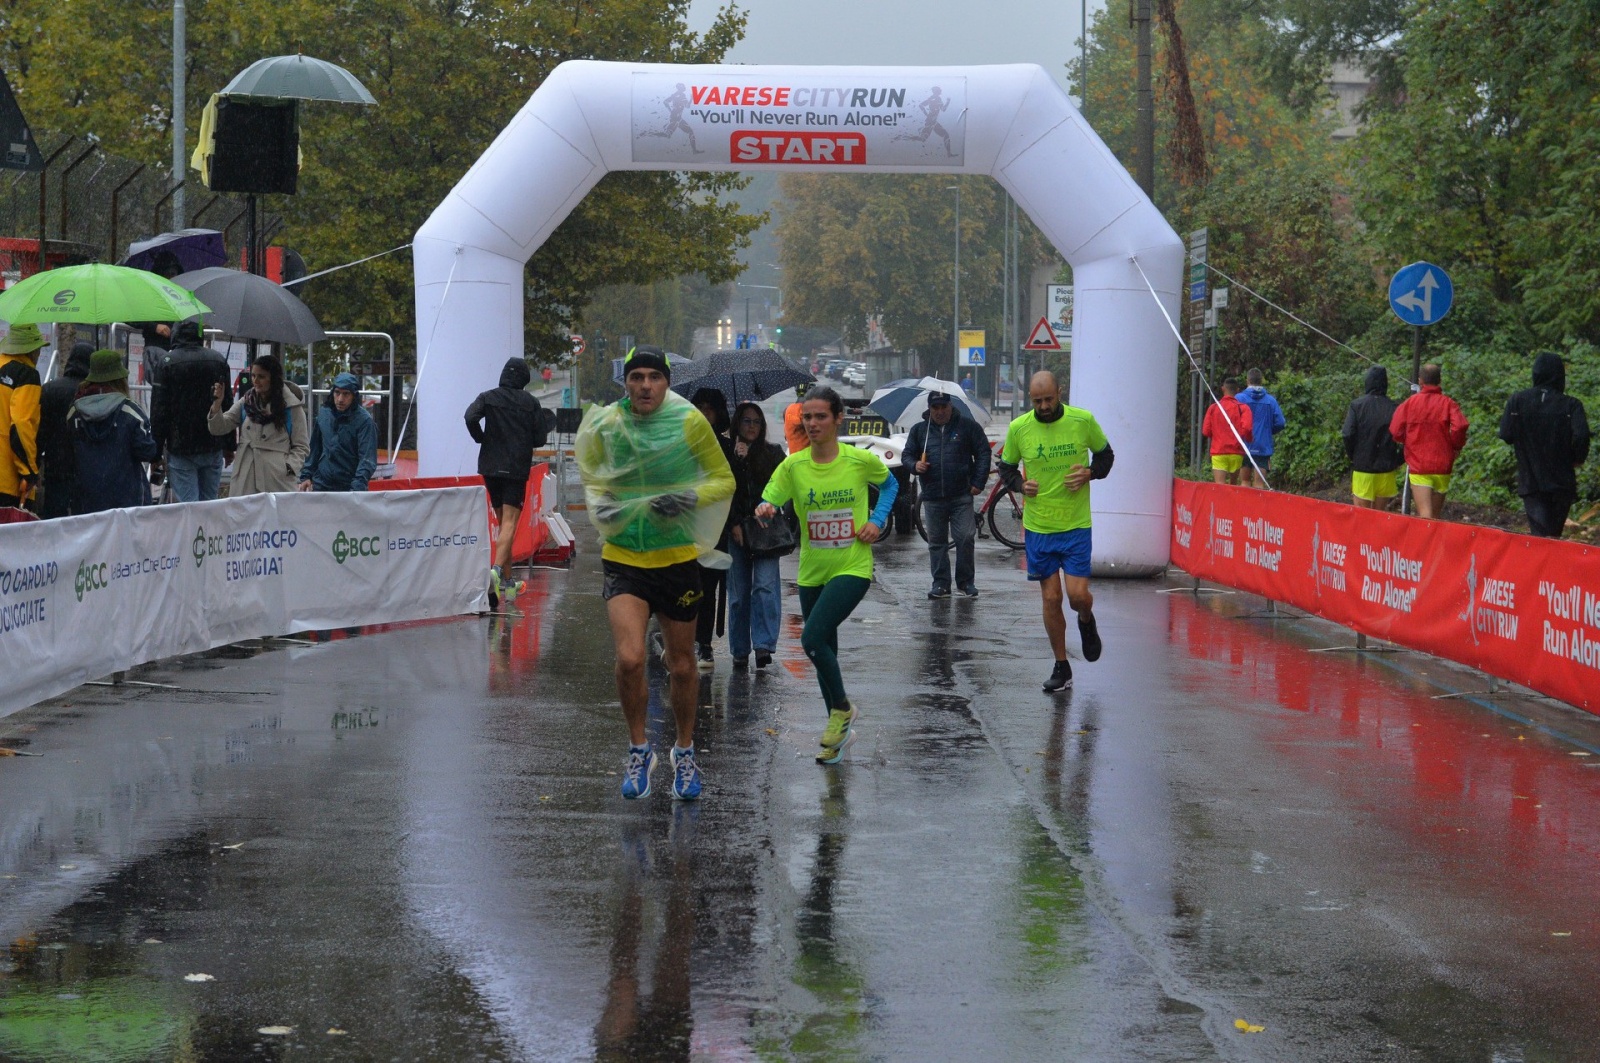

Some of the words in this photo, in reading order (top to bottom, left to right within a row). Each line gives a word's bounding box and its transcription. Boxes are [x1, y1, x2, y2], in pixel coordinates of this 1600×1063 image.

[691, 86, 790, 107] VARESE
[793, 87, 906, 108] CITYRUN
[690, 108, 744, 124] “You’ll
[750, 110, 802, 125] Never
[805, 111, 838, 126] Run
[843, 110, 906, 126] Alone!”
[737, 136, 860, 162] START
[1048, 449, 1077, 459] CITYRUN
[1049, 443, 1075, 452] VARESE
[821, 496, 855, 506] CITYRUN
[822, 488, 853, 498] VARESE
[432, 535, 451, 547] Che
[809, 520, 852, 539] 1088
[208, 535, 223, 557] BCC
[226, 532, 251, 554] BUSTO
[350, 536, 381, 557] BCC
[1322, 540, 1347, 567] VARESE
[85, 562, 108, 592] BCC
[1321, 565, 1346, 592] CITYRUN
[1392, 550, 1423, 583] Never
[1361, 574, 1381, 604] Run
[1481, 577, 1515, 609] VARESE
[1538, 580, 1581, 622] “You’ll
[1476, 606, 1519, 641] CITYRUN
[1543, 619, 1569, 659] Run
